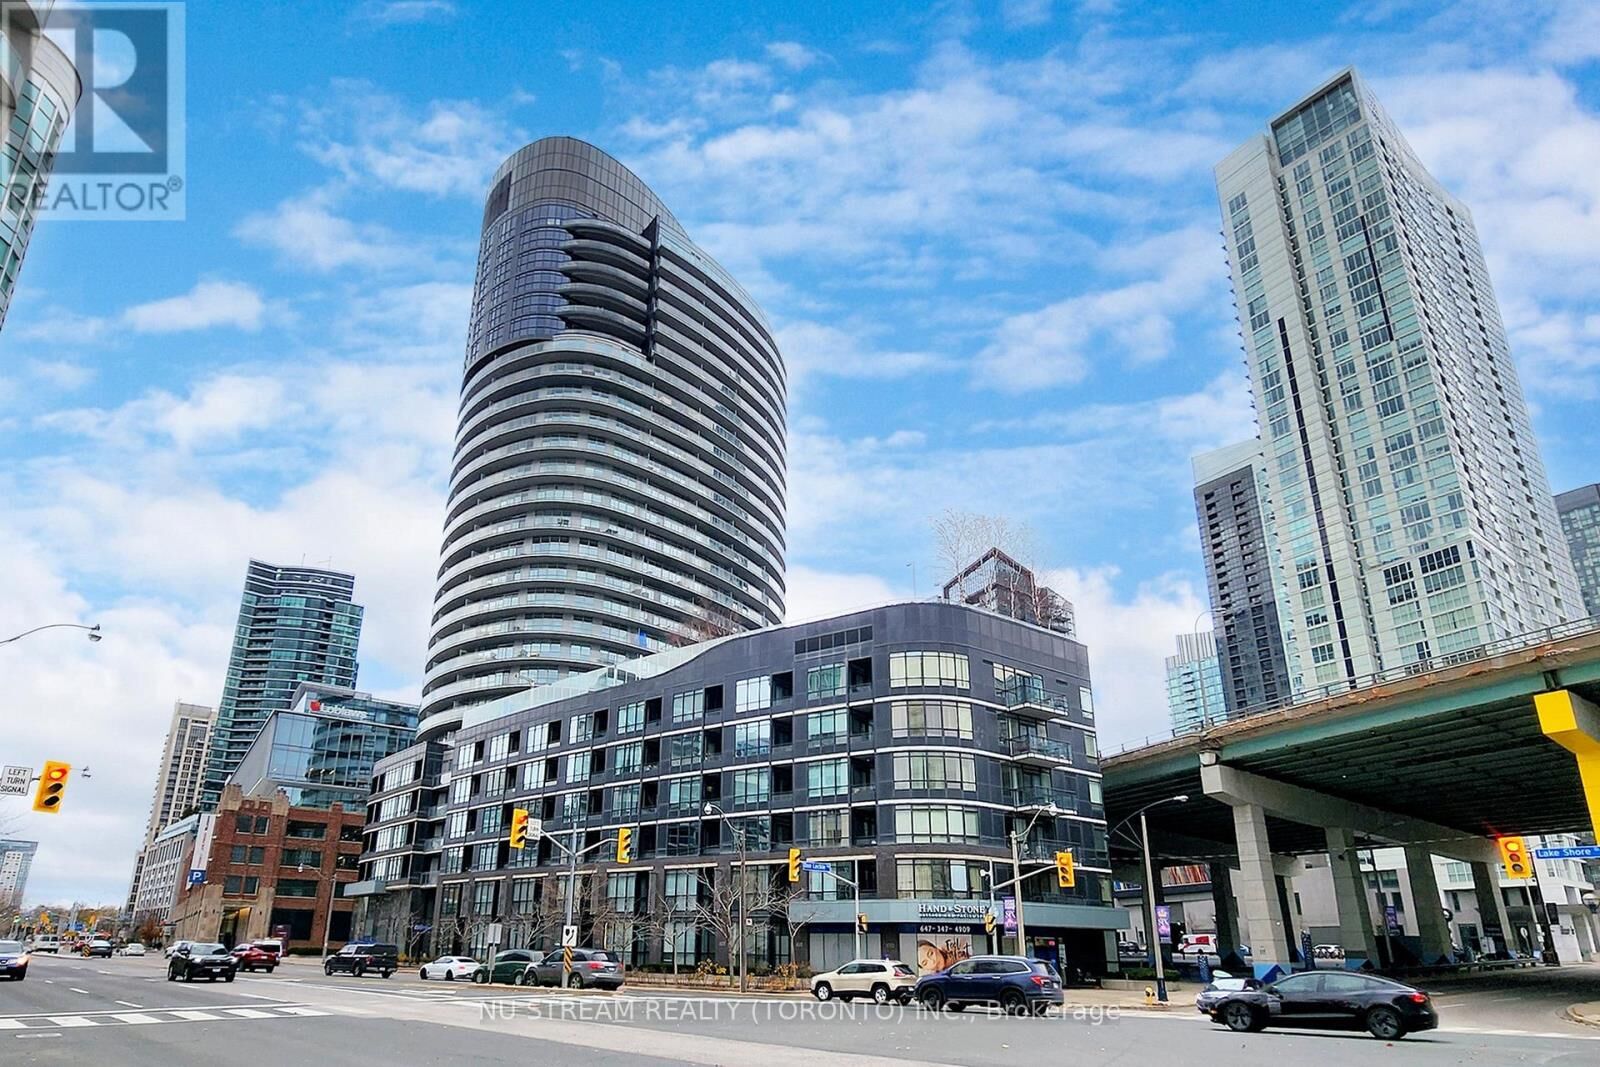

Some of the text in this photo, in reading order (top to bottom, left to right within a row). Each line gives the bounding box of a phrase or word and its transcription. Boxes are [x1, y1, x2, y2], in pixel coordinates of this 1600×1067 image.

[8, 768, 27, 776] LEFT
[6, 776, 26, 784] TURN
[0, 785, 26, 794] SIGNAL
[1562, 848, 1592, 857] Shore
[192, 872, 202, 880] P
[918, 903, 948, 913] HAND
[954, 903, 986, 913] STONE
